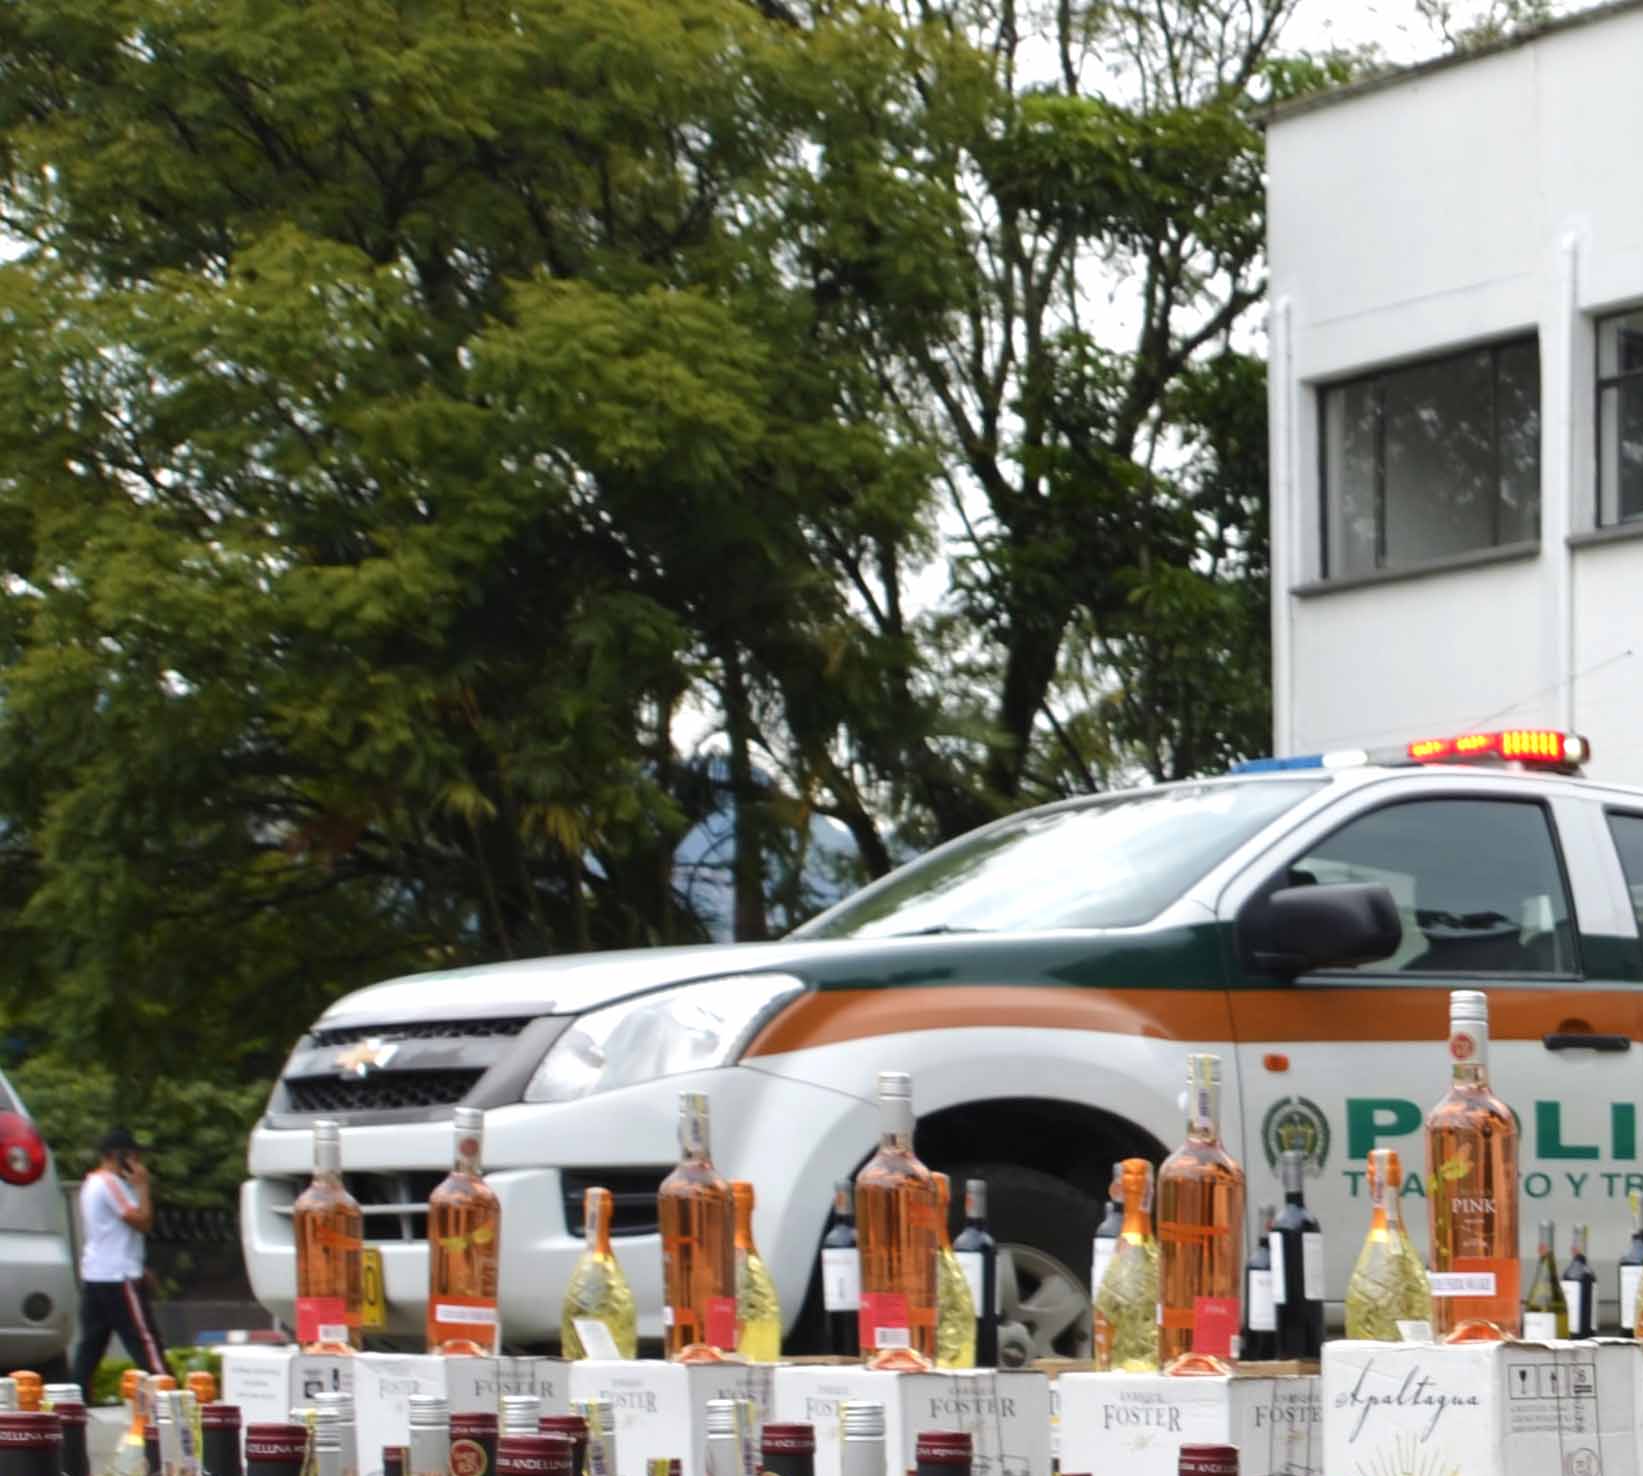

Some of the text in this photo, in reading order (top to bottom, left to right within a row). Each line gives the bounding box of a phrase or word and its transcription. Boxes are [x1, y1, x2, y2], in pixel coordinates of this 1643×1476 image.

[1452, 1198, 1496, 1214] PINK
[930, 1396, 1016, 1419] FOSTER
[1103, 1405, 1182, 1433] FOSTER
